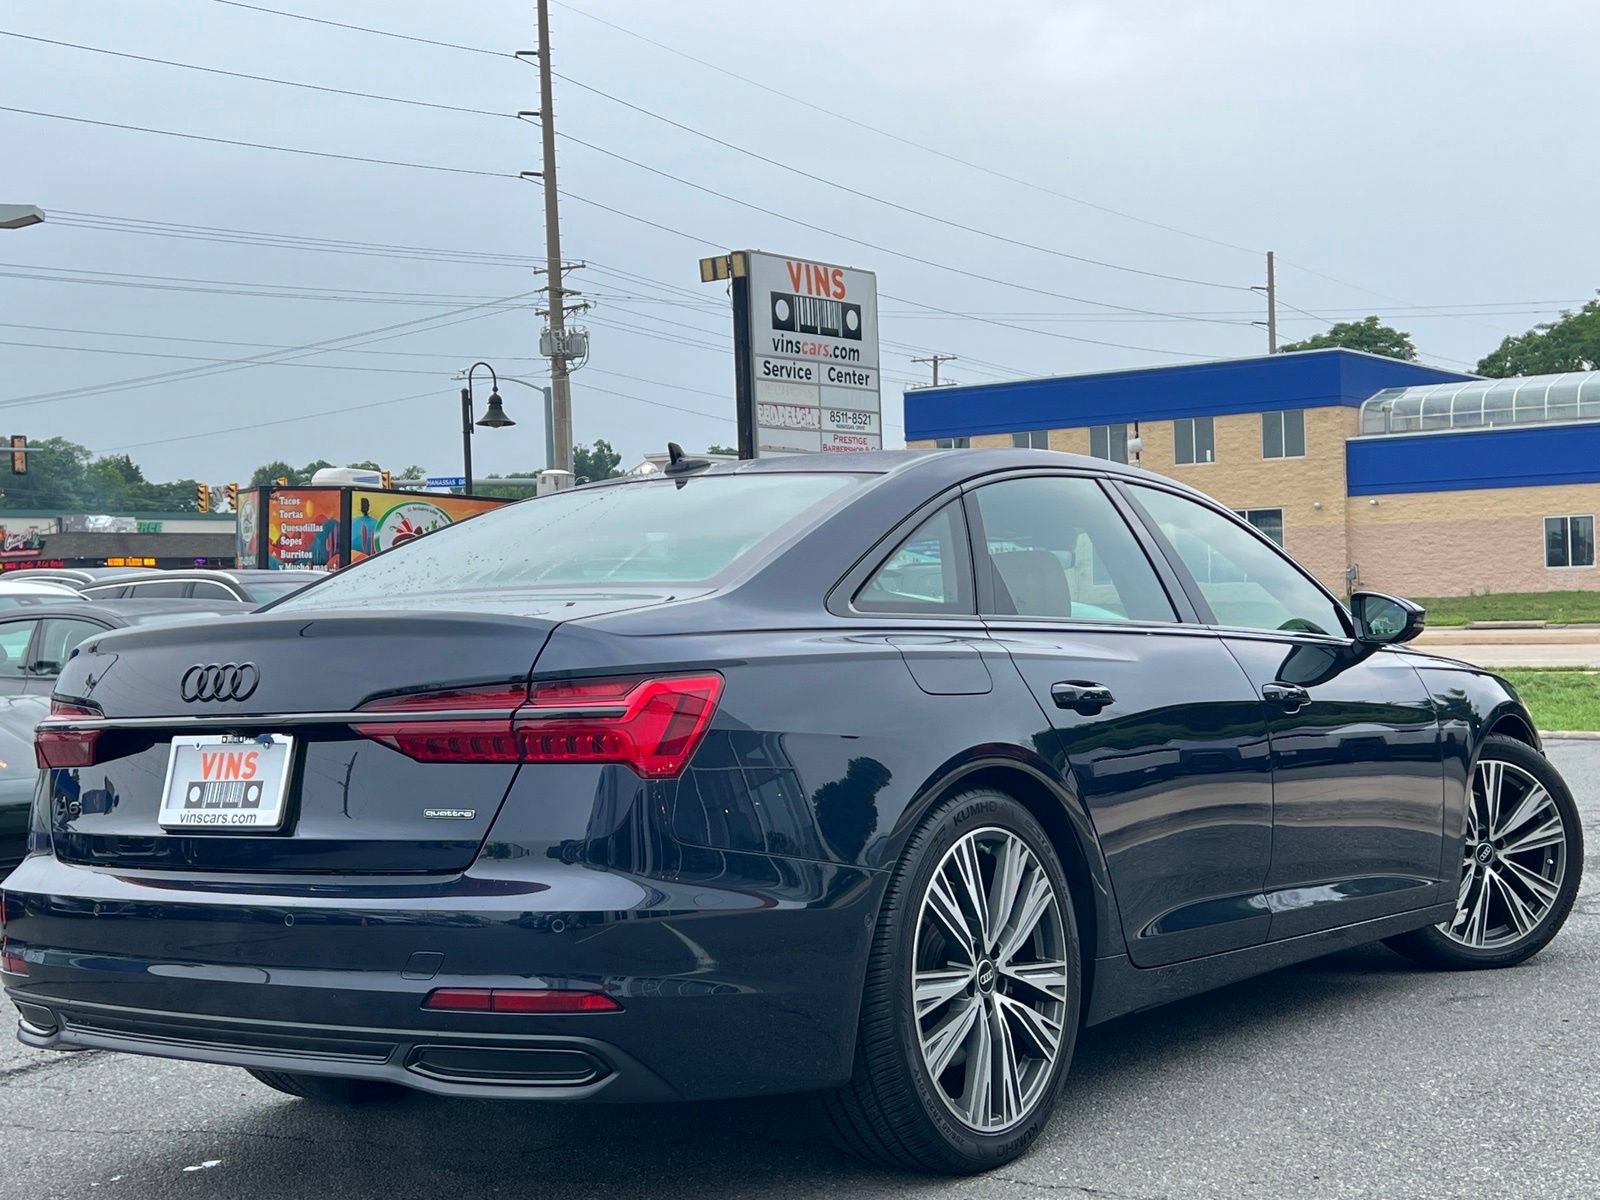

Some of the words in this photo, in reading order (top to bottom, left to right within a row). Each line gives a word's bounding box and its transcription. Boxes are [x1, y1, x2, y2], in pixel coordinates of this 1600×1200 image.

[786, 261, 846, 300] VINS
[772, 333, 860, 362] vinscars.com
[763, 360, 812, 380] Service
[828, 367, 870, 386] Center
[830, 410, 871, 425] 8511-8521
[279, 496, 301, 505] Tacos
[279, 510, 304, 519] Tortas
[281, 523, 324, 534] Quesadillas
[280, 536, 303, 547] Sopes
[280, 550, 313, 559] Burritos
[202, 751, 258, 780] VINS
[180, 810, 257, 824] vinscars.com
[953, 801, 999, 827] KUMHO
